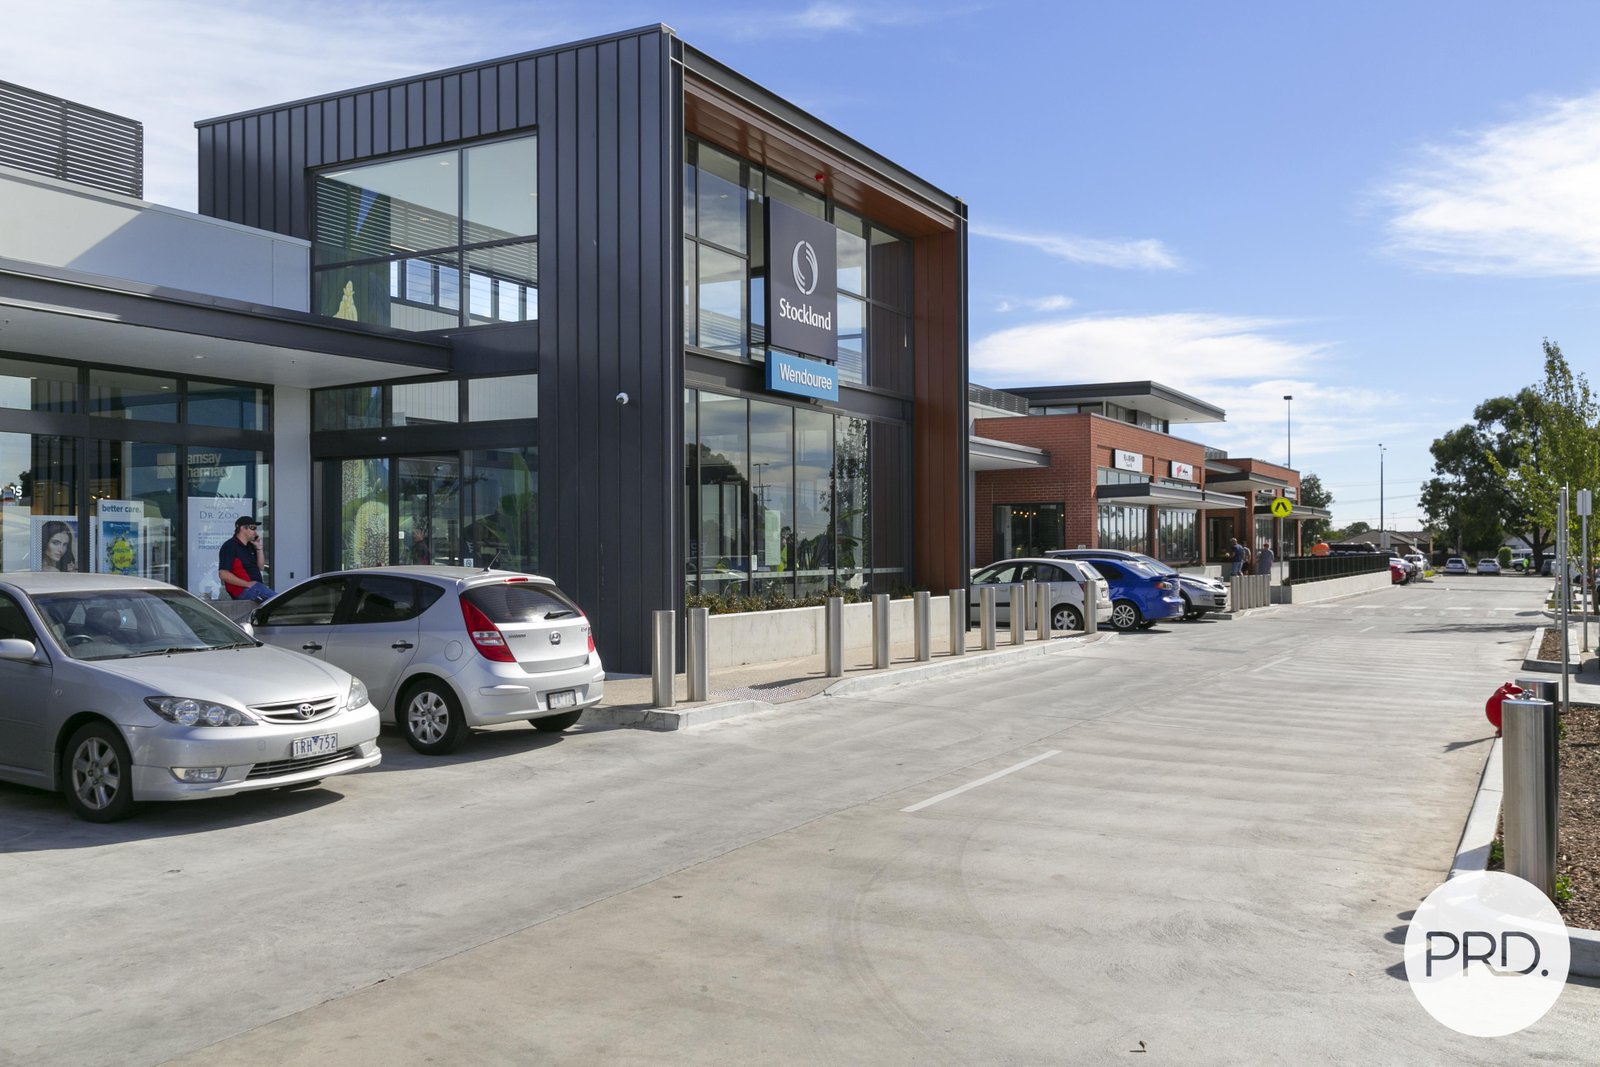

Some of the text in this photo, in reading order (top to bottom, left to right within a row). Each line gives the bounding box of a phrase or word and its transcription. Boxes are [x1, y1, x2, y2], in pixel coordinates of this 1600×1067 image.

[779, 298, 831, 331] Stockland
[779, 363, 832, 390] Wendouree
[187, 453, 222, 466] amsay
[102, 504, 123, 513] better
[295, 739, 313, 755] TRH
[320, 735, 336, 751] 752
